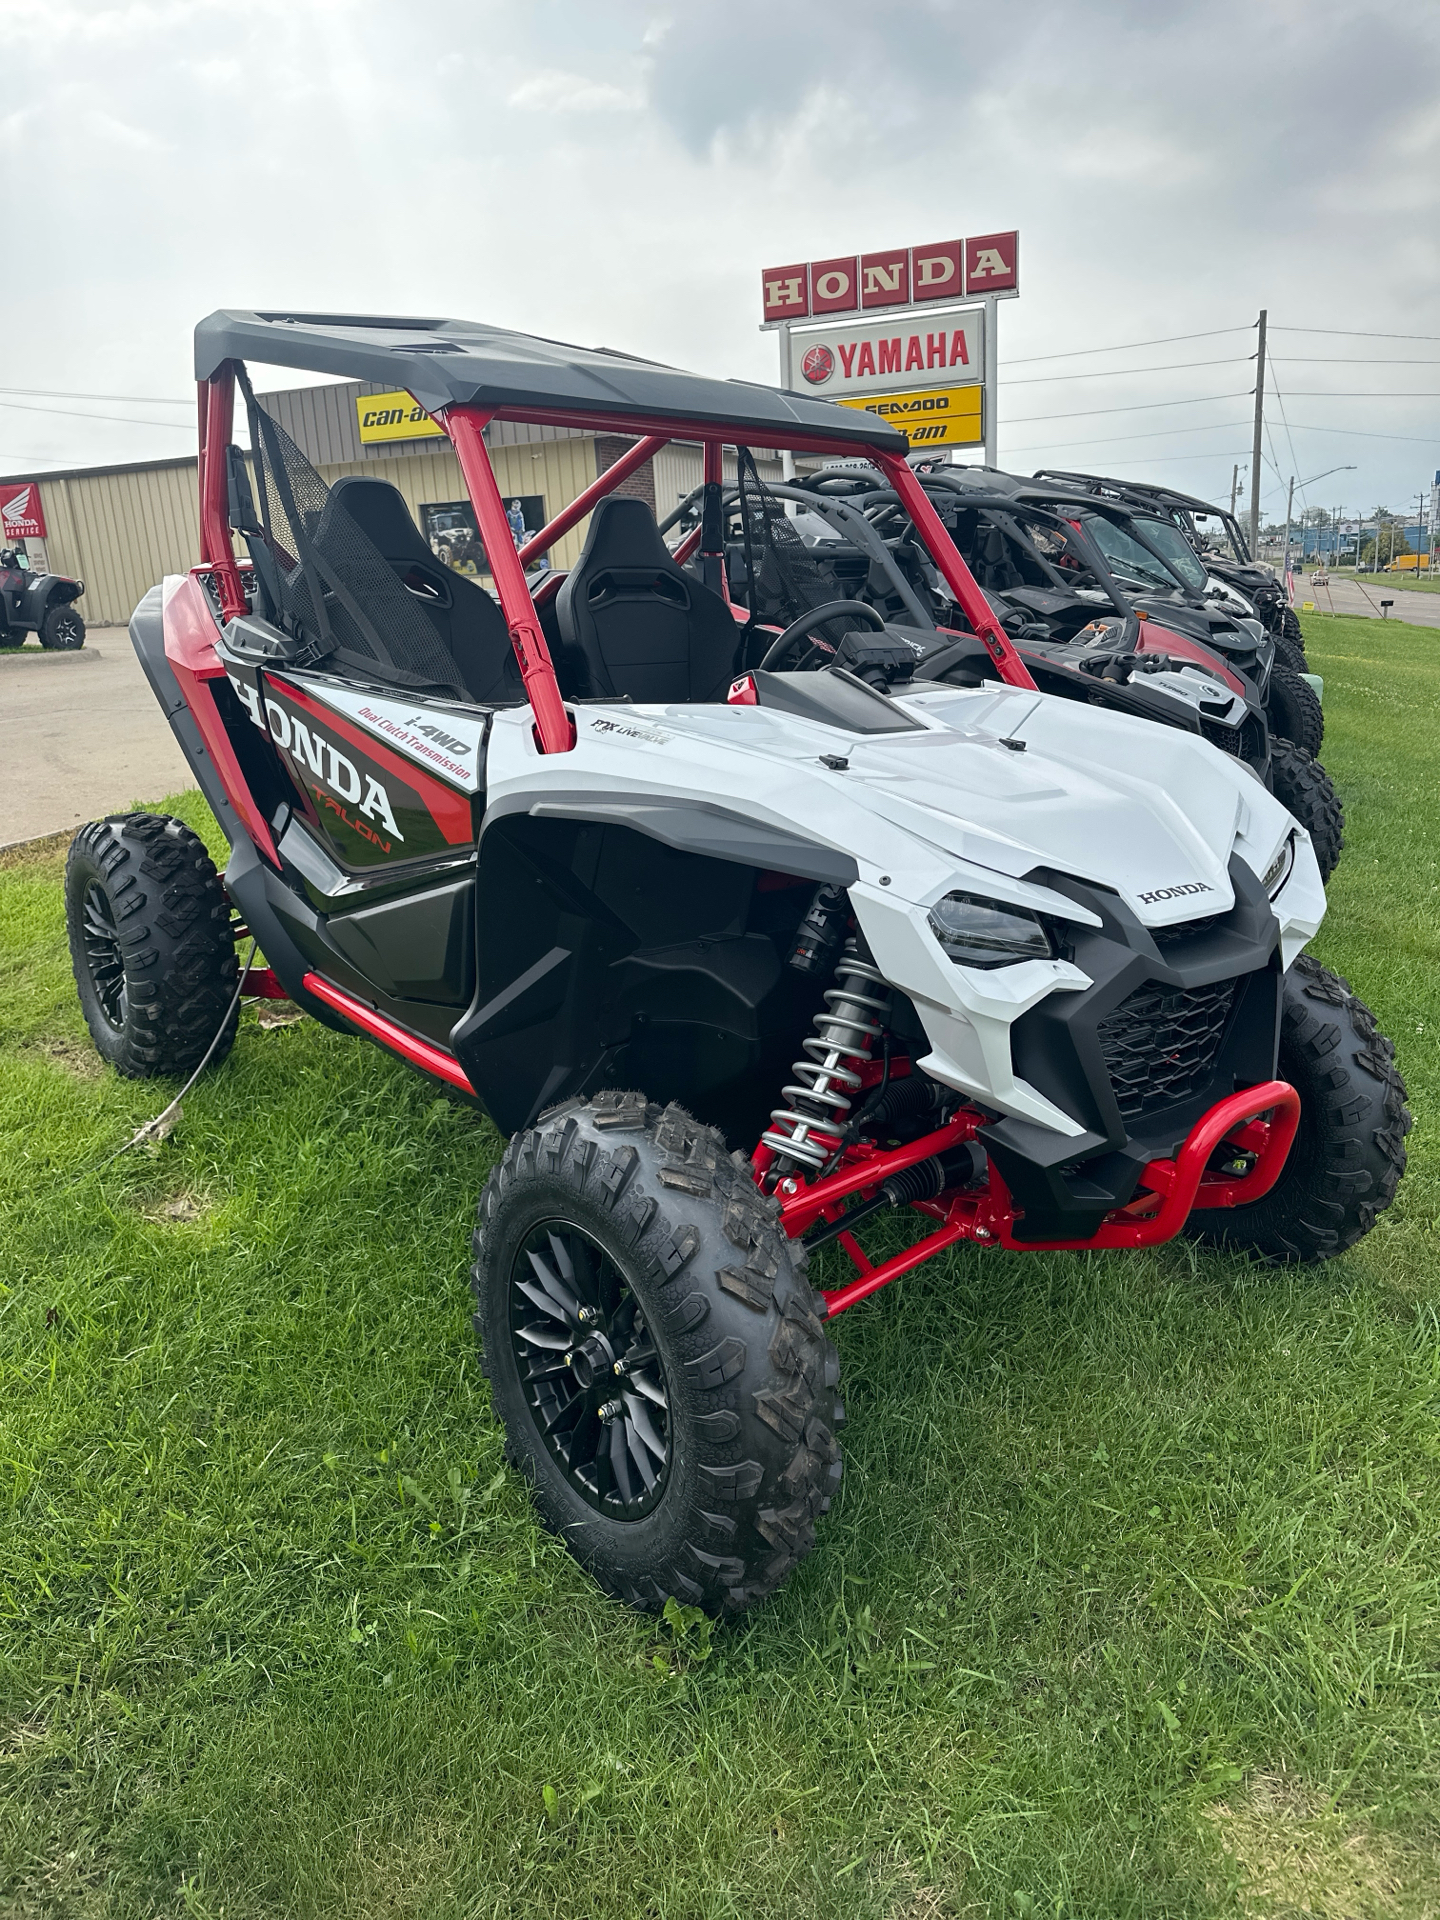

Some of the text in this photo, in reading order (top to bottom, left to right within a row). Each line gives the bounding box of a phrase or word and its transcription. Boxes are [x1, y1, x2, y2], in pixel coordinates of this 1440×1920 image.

[766, 249, 1011, 307] HONDA
[838, 330, 969, 378] YAMAHA
[4, 519, 38, 528] HONDA
[6, 527, 39, 536] SERVICE
[227, 672, 404, 842] HONDA
[358, 707, 471, 779] Dual Clutch Transmission
[404, 716, 472, 755] i-4WD
[312, 784, 391, 854] TALON
[1137, 882, 1214, 904] HONDA
